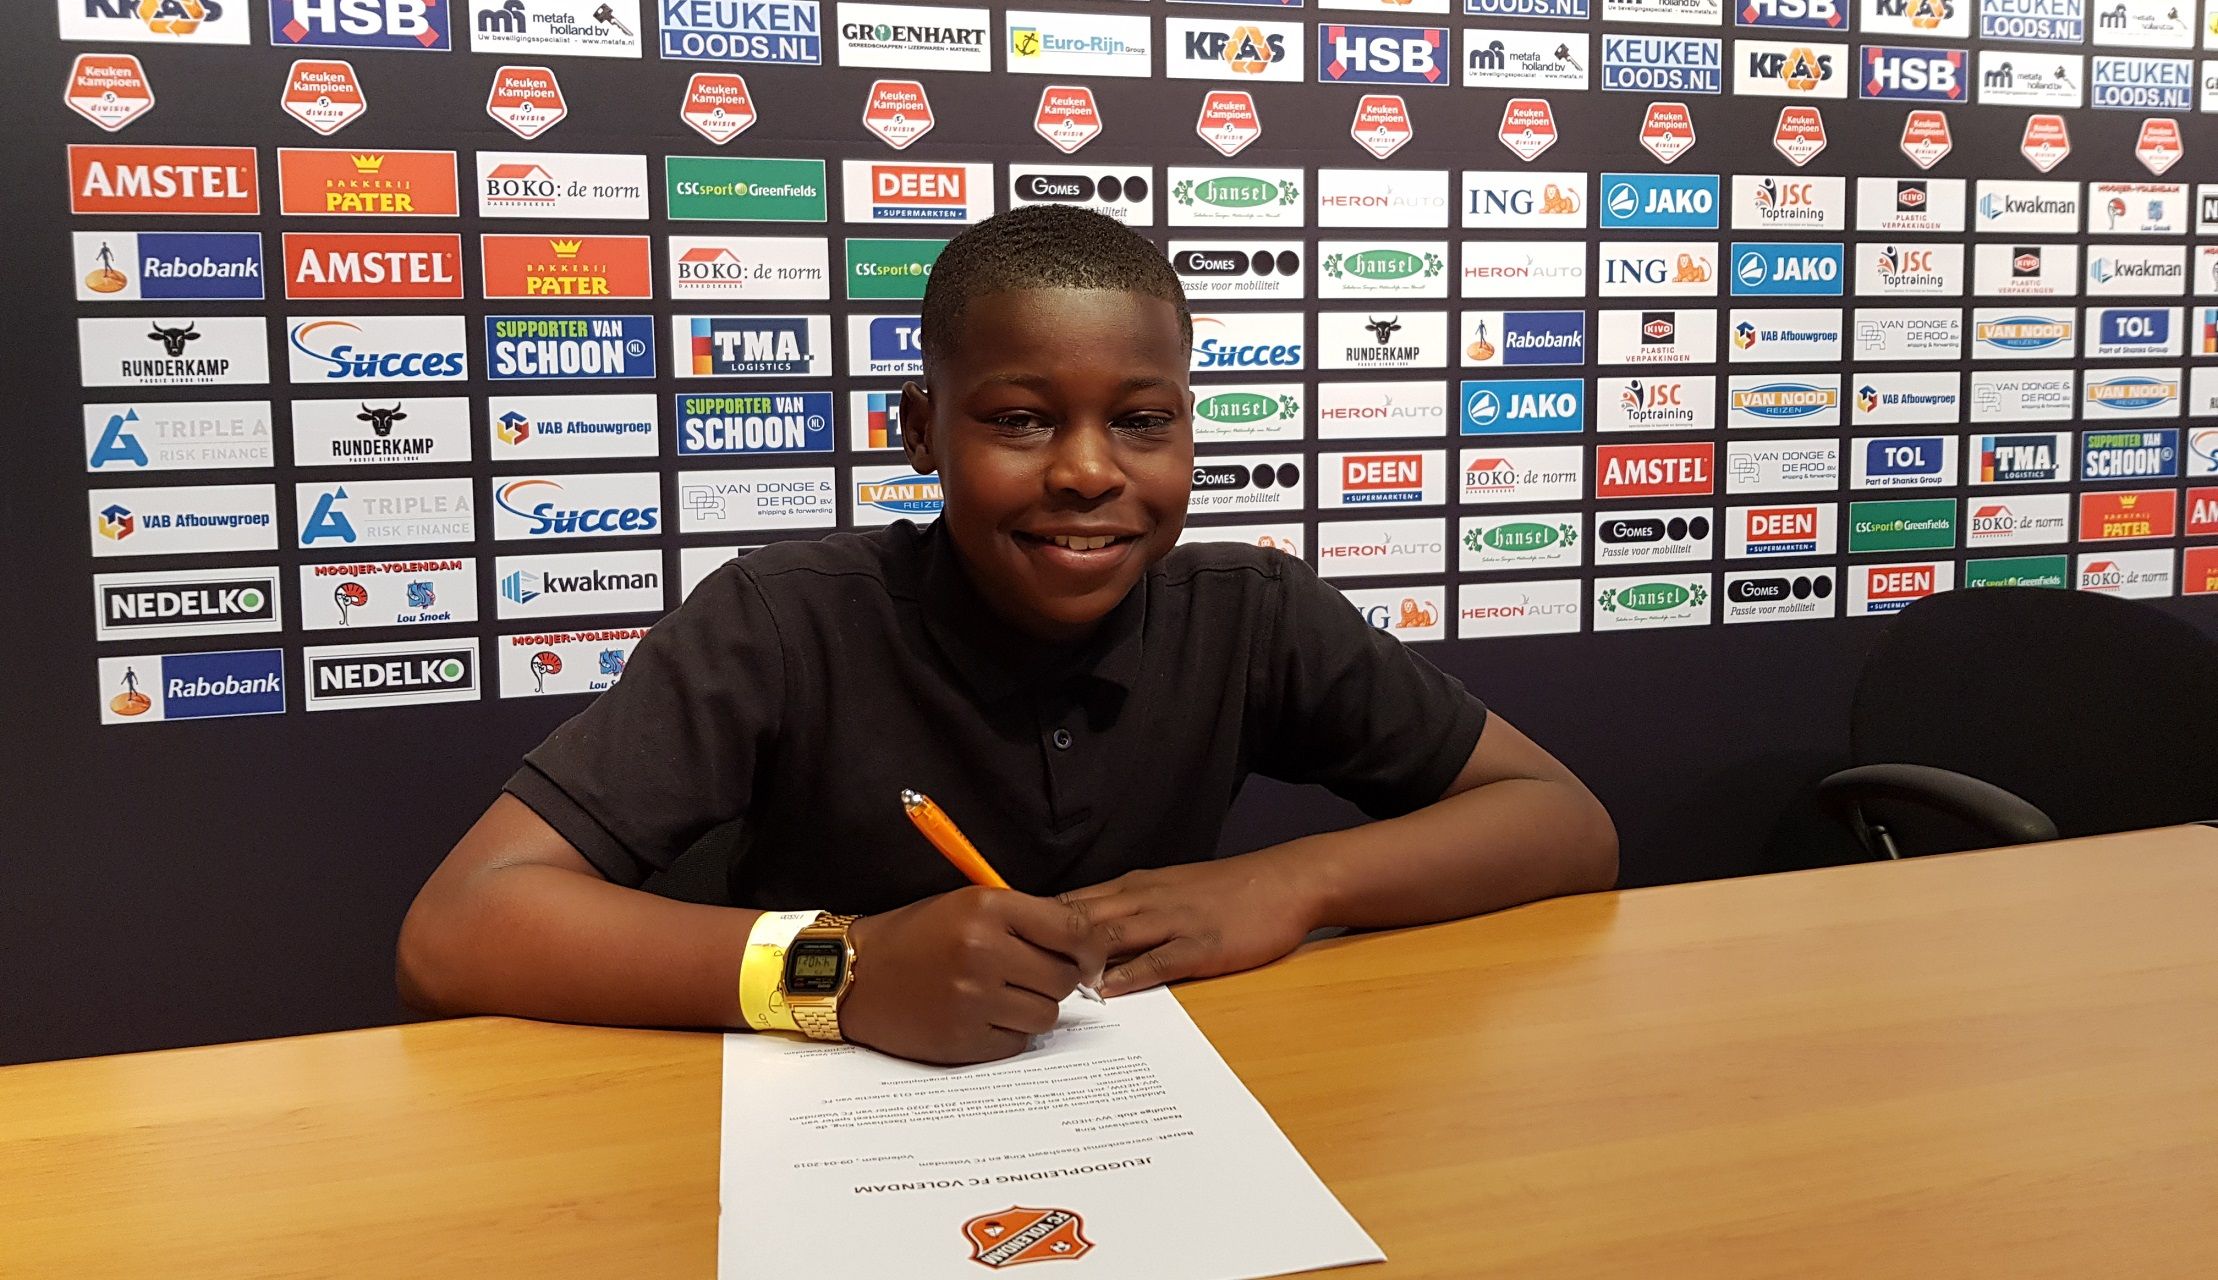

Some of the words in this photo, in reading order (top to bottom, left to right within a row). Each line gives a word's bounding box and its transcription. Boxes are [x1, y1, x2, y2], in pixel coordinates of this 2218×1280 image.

[532, 12, 575, 24] metafa
[664, 0, 816, 32] KEUKEN
[550, 23, 594, 35] holland
[594, 25, 609, 37] bv
[1983, 17, 2081, 39] LOODS.NL
[664, 33, 817, 61] LOODS.NL
[1043, 34, 1124, 56] Euro-Rijn
[1125, 46, 1145, 56] Group
[1185, 30, 1285, 63] KRAS
[1606, 38, 1718, 66] KEUKEN
[1333, 37, 1434, 73] HSB
[1510, 53, 1541, 62] metafa
[85, 66, 132, 78] Keuken
[1750, 51, 1832, 82] KRAS
[1874, 58, 1956, 91] HSB
[2096, 60, 2189, 85] KEUKEN
[77, 76, 140, 89] Kampioen
[301, 71, 345, 83] Keuken
[505, 77, 547, 88] Keuken
[1605, 69, 1718, 91] LOODS.NL
[293, 81, 354, 94] Kampioen
[498, 87, 555, 99] Kampioen
[698, 84, 738, 95] Keuken
[880, 90, 917, 101] Keuken
[692, 93, 745, 105] Kampioen
[873, 100, 924, 111] Kampioen
[1051, 97, 1086, 107] Keuken
[1212, 102, 1246, 111] Keuken
[1045, 105, 1092, 117] Kampioen
[1206, 110, 1252, 121] Kampioen
[1360, 113, 1404, 124] Kampioen
[1366, 105, 1398, 115] Keuken
[1513, 109, 1544, 119] Keuken
[1654, 112, 1683, 121] Keuken
[1507, 117, 1549, 127] Kampioen
[1787, 116, 1815, 125] Keuken
[82, 161, 248, 198] AMSTEL
[878, 173, 960, 198] DEEN
[326, 192, 414, 212] PATER
[1469, 189, 1534, 215] ING
[1644, 189, 1712, 214] JAKO
[1780, 184, 1812, 206] JSC
[883, 208, 957, 218] SUPERMARKTEN
[1761, 206, 1824, 221] Toptraining
[2005, 196, 2075, 216] kwakman
[144, 256, 259, 280] Rabobank
[295, 249, 452, 284] AMSTEL
[527, 264, 607, 273] BAKKERIJ
[1773, 257, 1837, 281] JAKO
[1901, 251, 1933, 273] JSC
[2115, 260, 2182, 277] kwakman
[752, 263, 773, 280] de
[777, 266, 822, 280] norm
[1605, 259, 1668, 284] ING
[526, 277, 610, 295] PATER
[496, 320, 588, 338] SUPPORTER
[593, 320, 623, 337] VAN
[1647, 325, 1671, 333] KIVO
[1880, 320, 1904, 328] VAN
[1907, 320, 1948, 328] DONGE
[2116, 318, 2153, 336] TOL
[630, 343, 642, 353] NL
[1506, 330, 1581, 349] Rabobank
[327, 345, 463, 378] Succes
[496, 341, 625, 375] SCHOON
[1197, 338, 1301, 368] Succes
[1346, 346, 1420, 361] RUNDERKAMP
[122, 359, 229, 377] RUNDERKAMP
[731, 362, 791, 372] LOGISTICS
[870, 363, 891, 373] Part
[893, 363, 903, 373] of
[1648, 384, 1681, 407] JSC
[1740, 393, 1776, 406] VAN
[1781, 392, 1829, 405] NOOD
[686, 398, 771, 414] SUPPORTER
[775, 397, 804, 413] VAN
[1322, 407, 1387, 419] HERON
[1391, 406, 1443, 418] AUTO
[1506, 393, 1577, 419] JAKO
[1627, 408, 1694, 423] Toptraining
[155, 419, 244, 438] TRIPLE
[253, 418, 268, 436] A
[537, 420, 563, 434] VAB
[567, 419, 652, 435] Afbouwgroep
[686, 415, 804, 450] SCHOON
[160, 447, 195, 461] RISK
[202, 446, 268, 460] FINANCE
[333, 438, 434, 457] RUNDERKAMP
[1885, 447, 1925, 467] TOL
[2087, 449, 2161, 476] SCHOON
[1348, 460, 1417, 483] DEEN
[1603, 457, 1707, 486] AMSTEL
[2004, 471, 2045, 479] LOGISTICS
[1866, 477, 1881, 485] Part
[1882, 477, 1890, 485] of
[1891, 477, 1918, 485] Shanks
[1919, 476, 1942, 485] Group
[363, 496, 447, 515] TRIPLE
[454, 495, 470, 512] A
[1352, 493, 1413, 502] SUPERMARKTEN
[142, 514, 171, 528] VAB
[175, 513, 270, 529] Afbouwgroep
[529, 502, 657, 535] Succes
[758, 509, 785, 517] shipping
[366, 524, 401, 538] RISK
[407, 522, 470, 536] FINANCE
[1750, 513, 1812, 536] DEEN
[2104, 522, 2150, 536] PATER
[1322, 545, 1387, 557] HERON
[1390, 543, 1442, 555] AUTO
[1602, 547, 1629, 558] Passie
[1631, 547, 1650, 556] voor
[1652, 544, 1691, 556] mobiliteit
[1754, 543, 1809, 553] SUPERMARKTEN
[314, 560, 462, 577] MOOIJER-VOLENDAM
[543, 568, 658, 595] kwakman
[1872, 571, 1930, 593] DEEN
[111, 588, 265, 619] NEDELKO
[1731, 606, 1755, 617] Passie
[1756, 606, 1775, 615] voor
[1777, 603, 1815, 614] mobiliteit
[397, 612, 417, 623] Lou
[419, 611, 451, 622] Snoek
[320, 658, 465, 690] NEDELKO
[167, 673, 280, 699] Rabobank
[589, 680, 608, 690] Lou
[996, 1157, 1151, 1182] JEUGDOPLEIDING
[854, 1180, 963, 1193] VOLENDAM
[968, 1177, 990, 1187] FC
